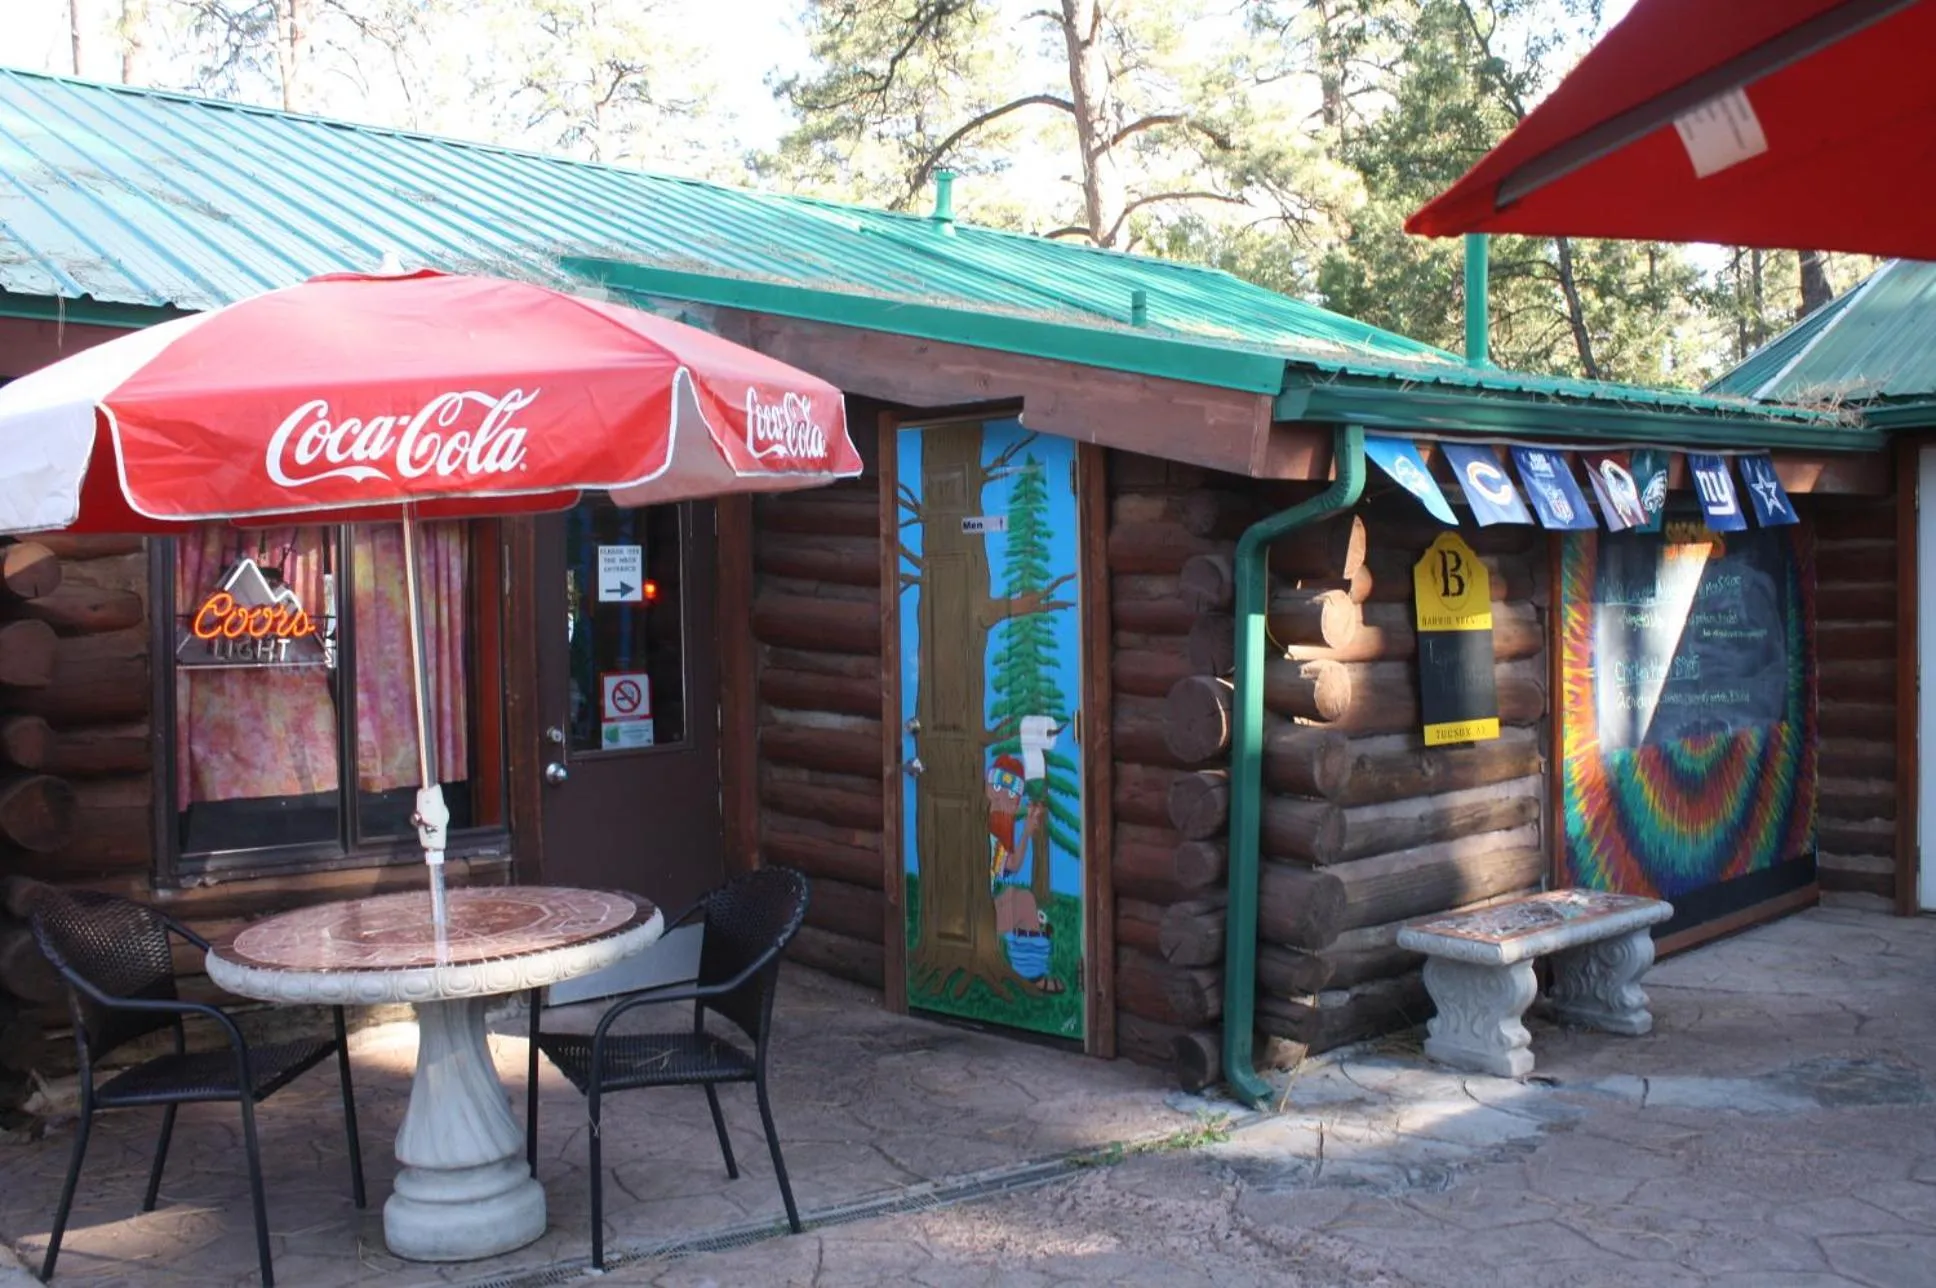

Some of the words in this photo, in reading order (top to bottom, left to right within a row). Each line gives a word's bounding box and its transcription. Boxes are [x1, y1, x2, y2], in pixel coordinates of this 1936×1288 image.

[265, 387, 541, 487] Coca-Cola
[746, 386, 827, 459] Coca-Cola
[963, 521, 983, 529] Men
[1438, 549, 1465, 597] B
[194, 592, 316, 640] Coors
[214, 638, 291, 663] LIGHT
